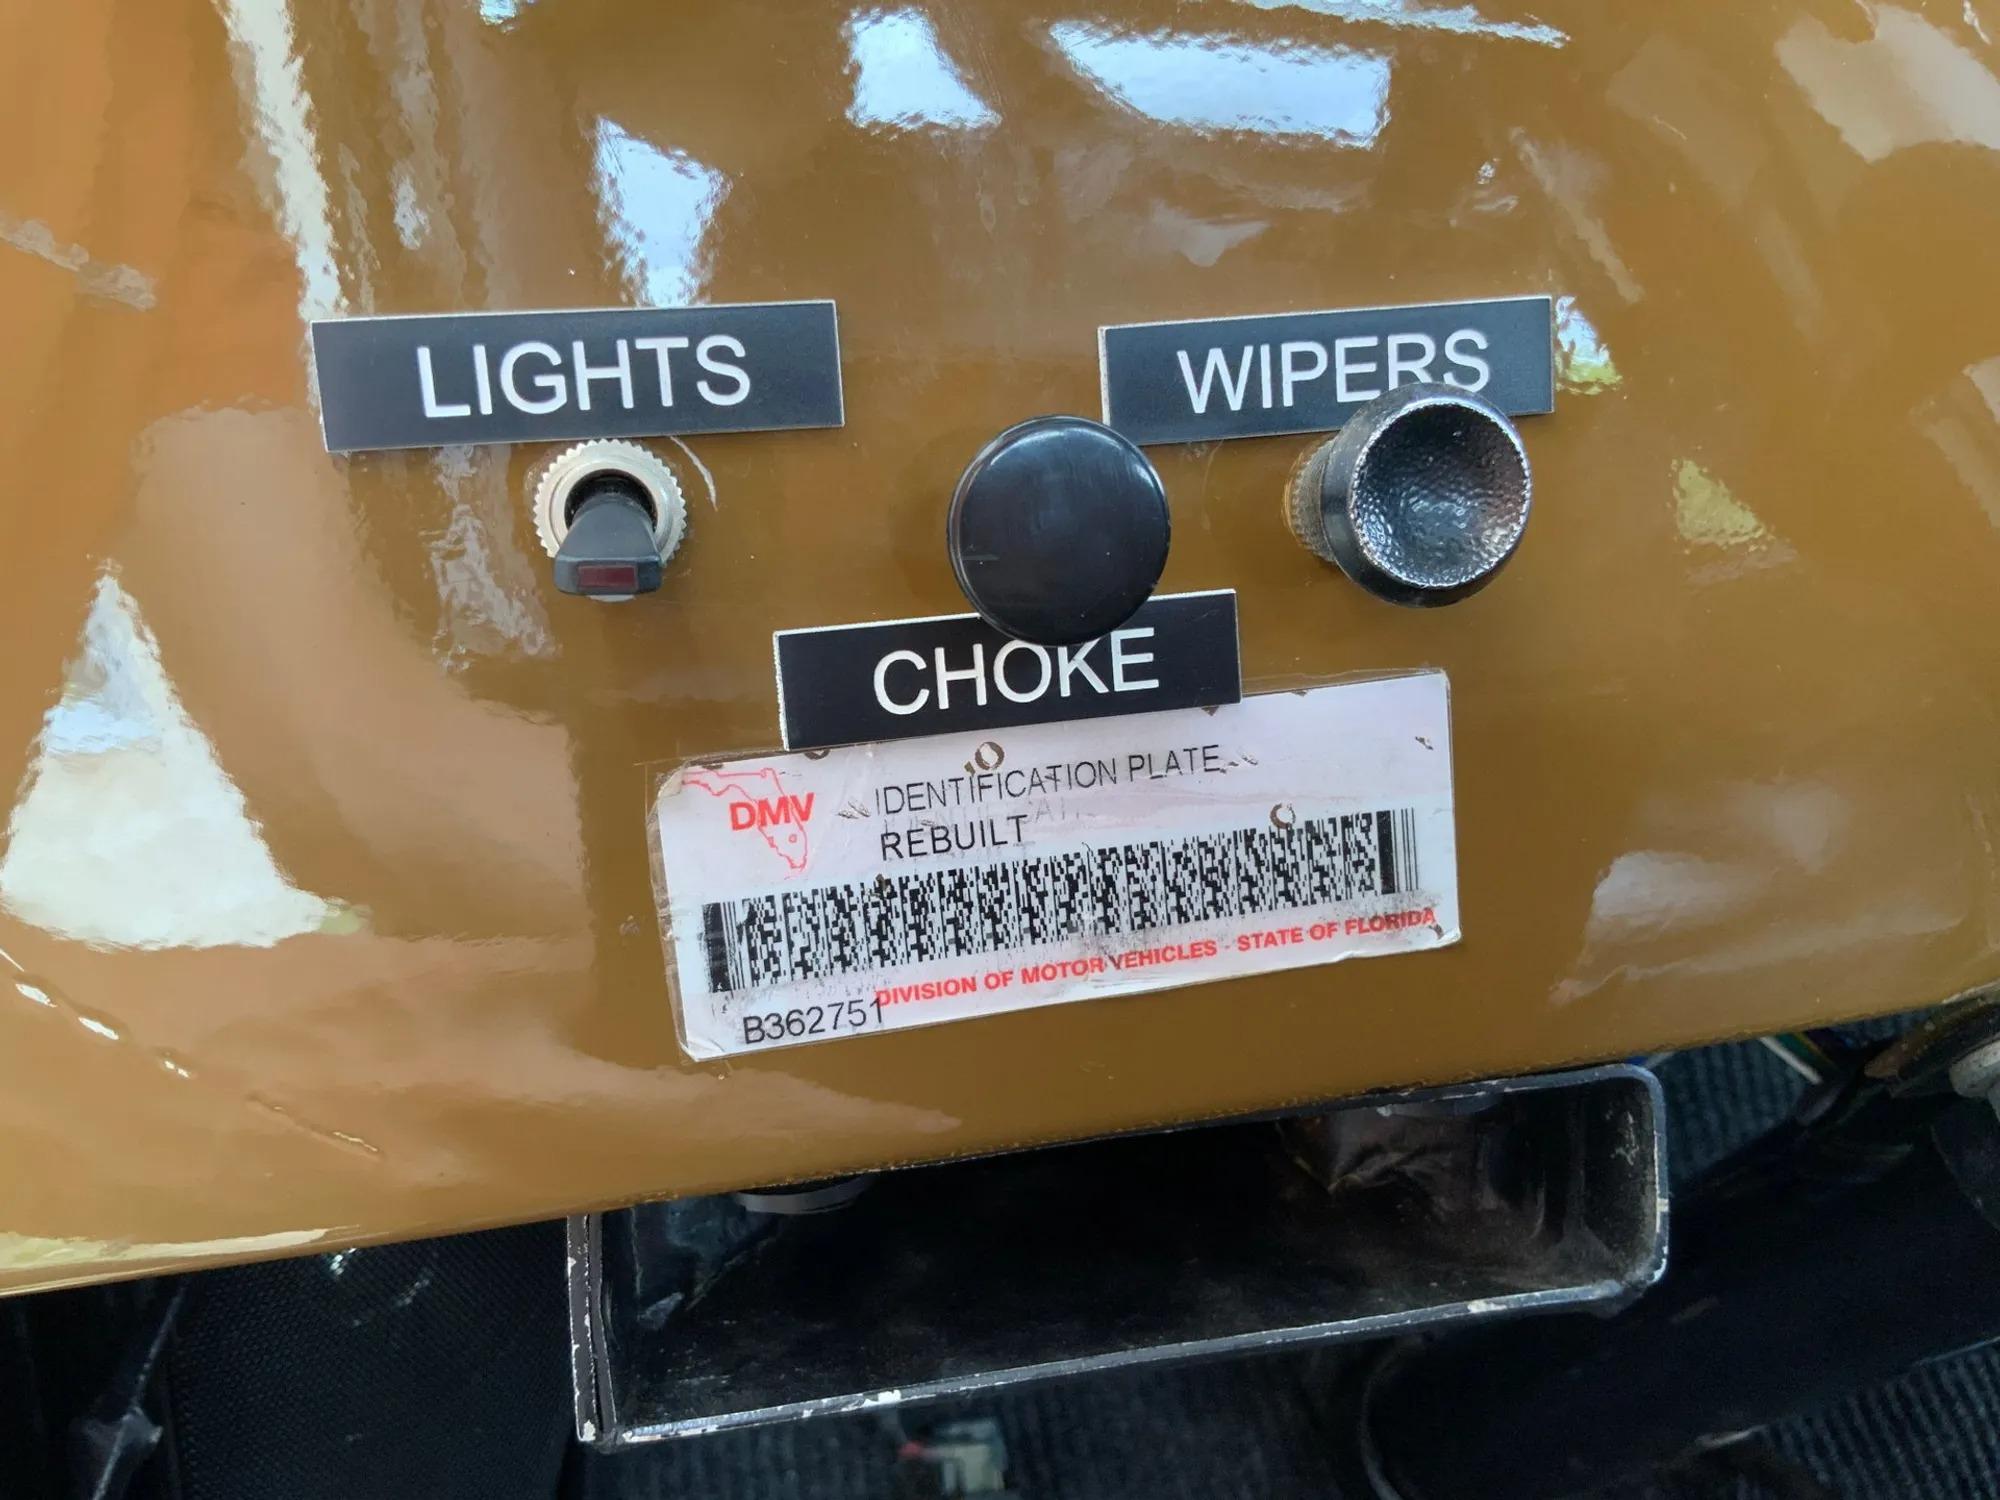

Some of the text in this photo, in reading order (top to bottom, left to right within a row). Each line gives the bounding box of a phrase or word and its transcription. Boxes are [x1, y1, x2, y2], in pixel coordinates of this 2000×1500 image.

[416, 335, 751, 418] LIGHTS
[1176, 329, 1490, 415] WIPERS
[873, 627, 1160, 716] CHOKE
[729, 792, 815, 831] DMV
[875, 757, 1117, 816] IDENTIFICATION
[1128, 744, 1221, 783] PLATE
[880, 814, 1028, 861] REBUILT
[875, 976, 977, 1007] DIVISION
[984, 971, 1014, 990] OF
[1021, 957, 1104, 984] MOTOR
[1107, 940, 1217, 970] VEHICLES
[1237, 927, 1303, 951] STATE
[1308, 921, 1338, 942] OF
[1345, 907, 1436, 936] FLORIDA
[743, 997, 883, 1044] B362751
